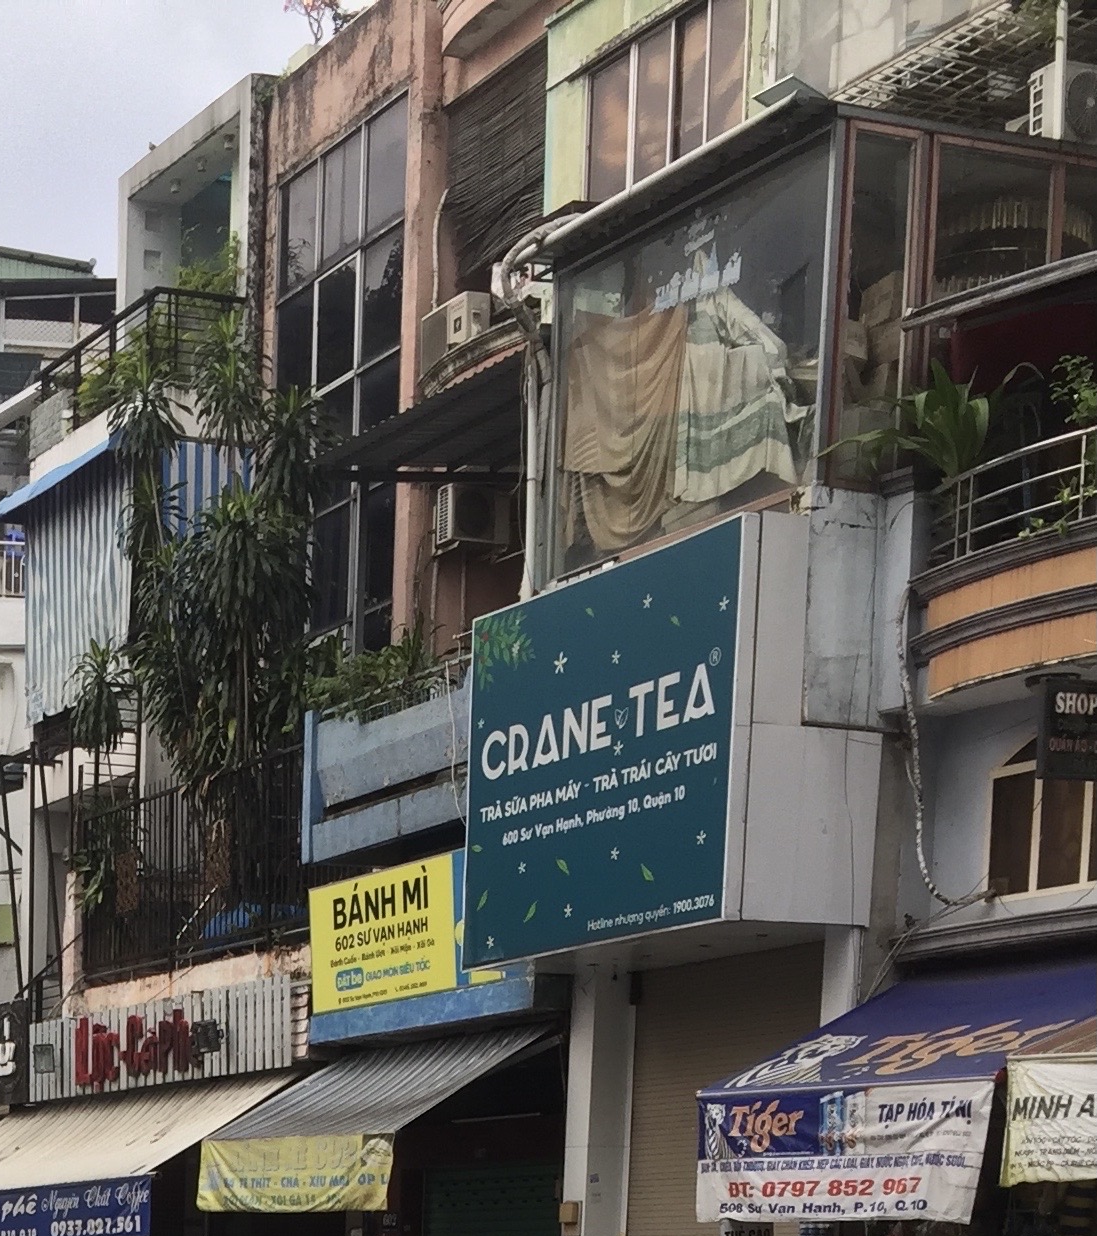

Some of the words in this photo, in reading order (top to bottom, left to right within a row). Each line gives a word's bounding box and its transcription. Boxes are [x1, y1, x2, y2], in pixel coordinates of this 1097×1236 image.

[481, 695, 612, 780] CRANE
[629, 662, 715, 737] TEA
[530, 790, 553, 806] PHA
[555, 780, 581, 804] MÁY
[655, 750, 681, 776] CÂY
[683, 742, 717, 768] TƯƠI
[502, 829, 518, 846] 600
[535, 822, 554, 839] Vạn
[555, 815, 584, 834] Hạnh,
[586, 801, 625, 825] Phường
[627, 796, 641, 813] 10,
[643, 791, 671, 809] Quận
[673, 784, 686, 801] 10
[333, 883, 396, 931] BÁNH
[403, 865, 429, 914] MÌ
[587, 917, 613, 932] Hotline
[673, 894, 715, 914] 1900.3076
[335, 933, 355, 952] 602
[357, 928, 374, 947] SƯ
[373, 924, 395, 946] VẠN
[398, 916, 429, 940] HẠNH
[837, 1019, 1076, 1076] Tiger
[728, 1100, 803, 1153] Tiger
[878, 1103, 905, 1129] TẠP
[907, 1097, 935, 1121] HÓA
[1012, 1094, 1073, 1122] MINH
[728, 1182, 754, 1198] ĐT:
[761, 1180, 820, 1197] 0797
[827, 1178, 873, 1197] 852
[883, 1176, 922, 1195] 967
[1, 1193, 37, 1223] phê
[768, 1203, 795, 1215] Vạn
[802, 1201, 846, 1215] Hạnh,
